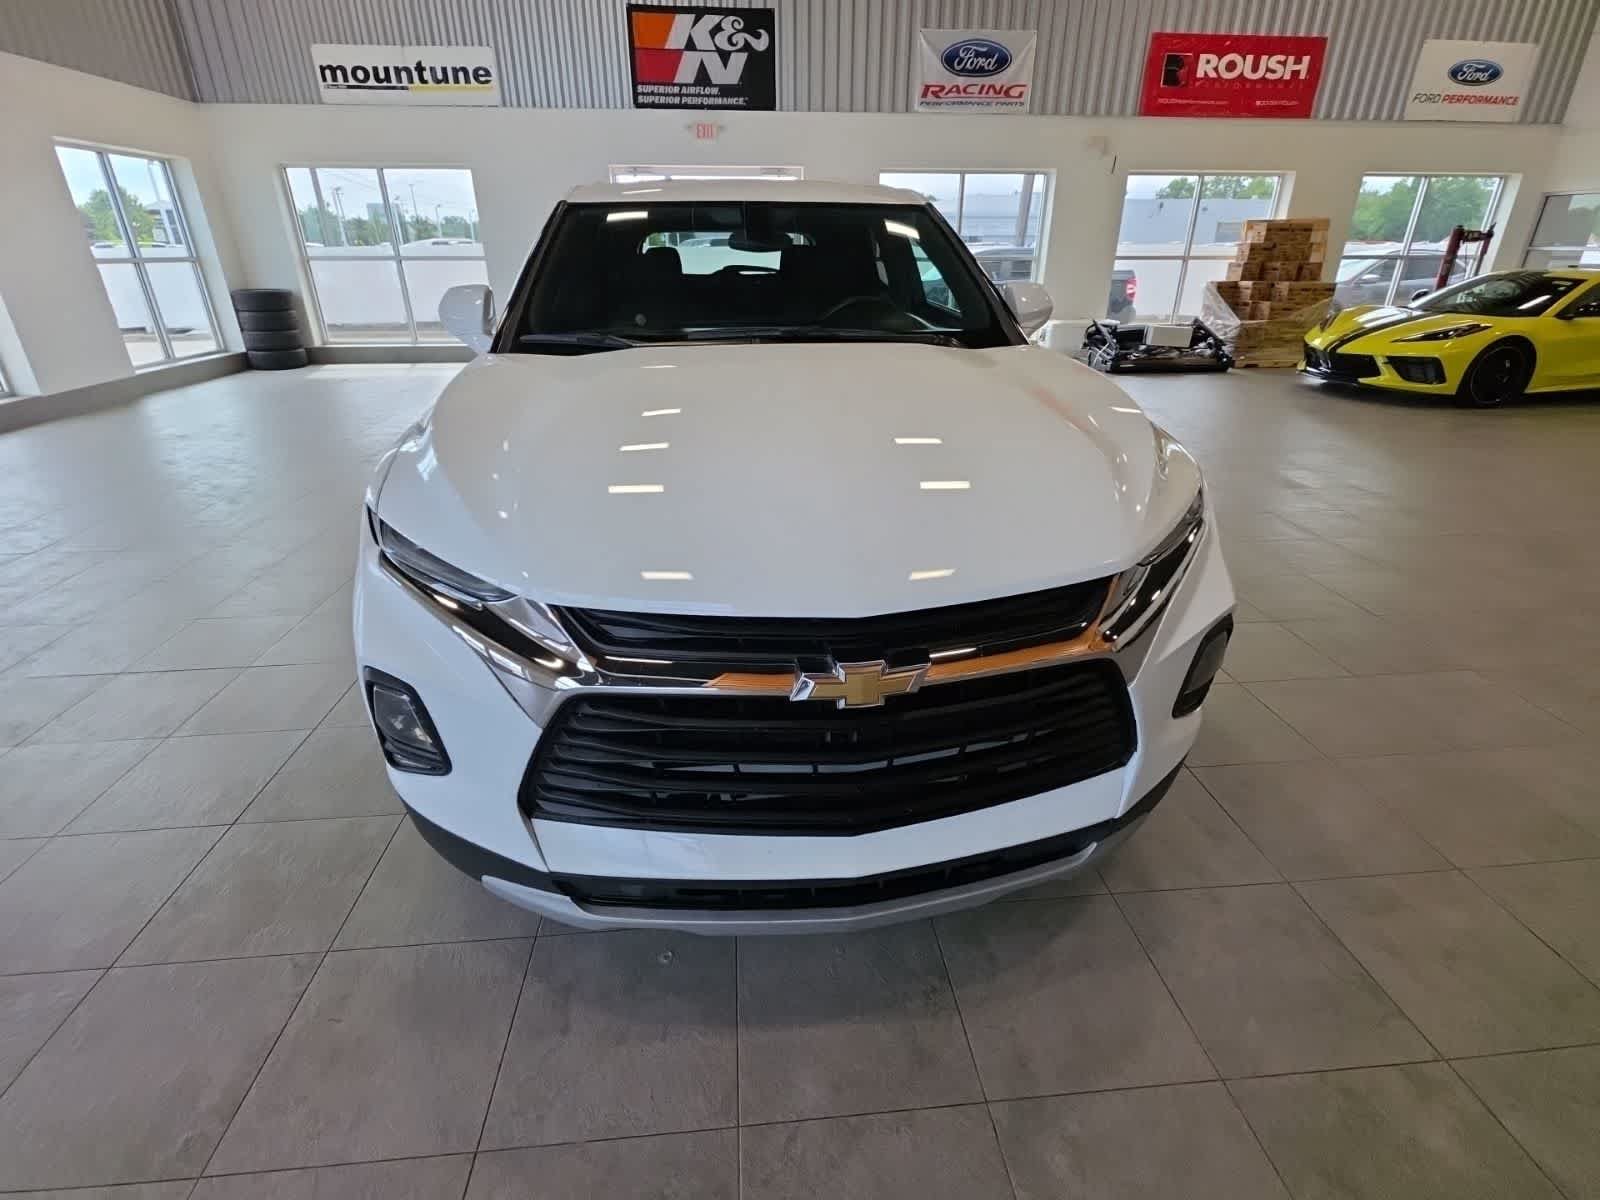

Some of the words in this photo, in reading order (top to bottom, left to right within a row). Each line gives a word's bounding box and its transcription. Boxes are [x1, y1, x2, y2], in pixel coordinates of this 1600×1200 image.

[954, 45, 999, 70] Ford
[319, 60, 492, 84] mountune
[1196, 53, 1311, 80] ROUSH
[1457, 63, 1494, 81] Ford
[637, 85, 680, 94] SUPERIOR
[921, 84, 1027, 99] RACING
[638, 95, 681, 104] SUPERIOR
[1412, 93, 1441, 104] FORD
[1441, 94, 1520, 105] PERFORMANCE
